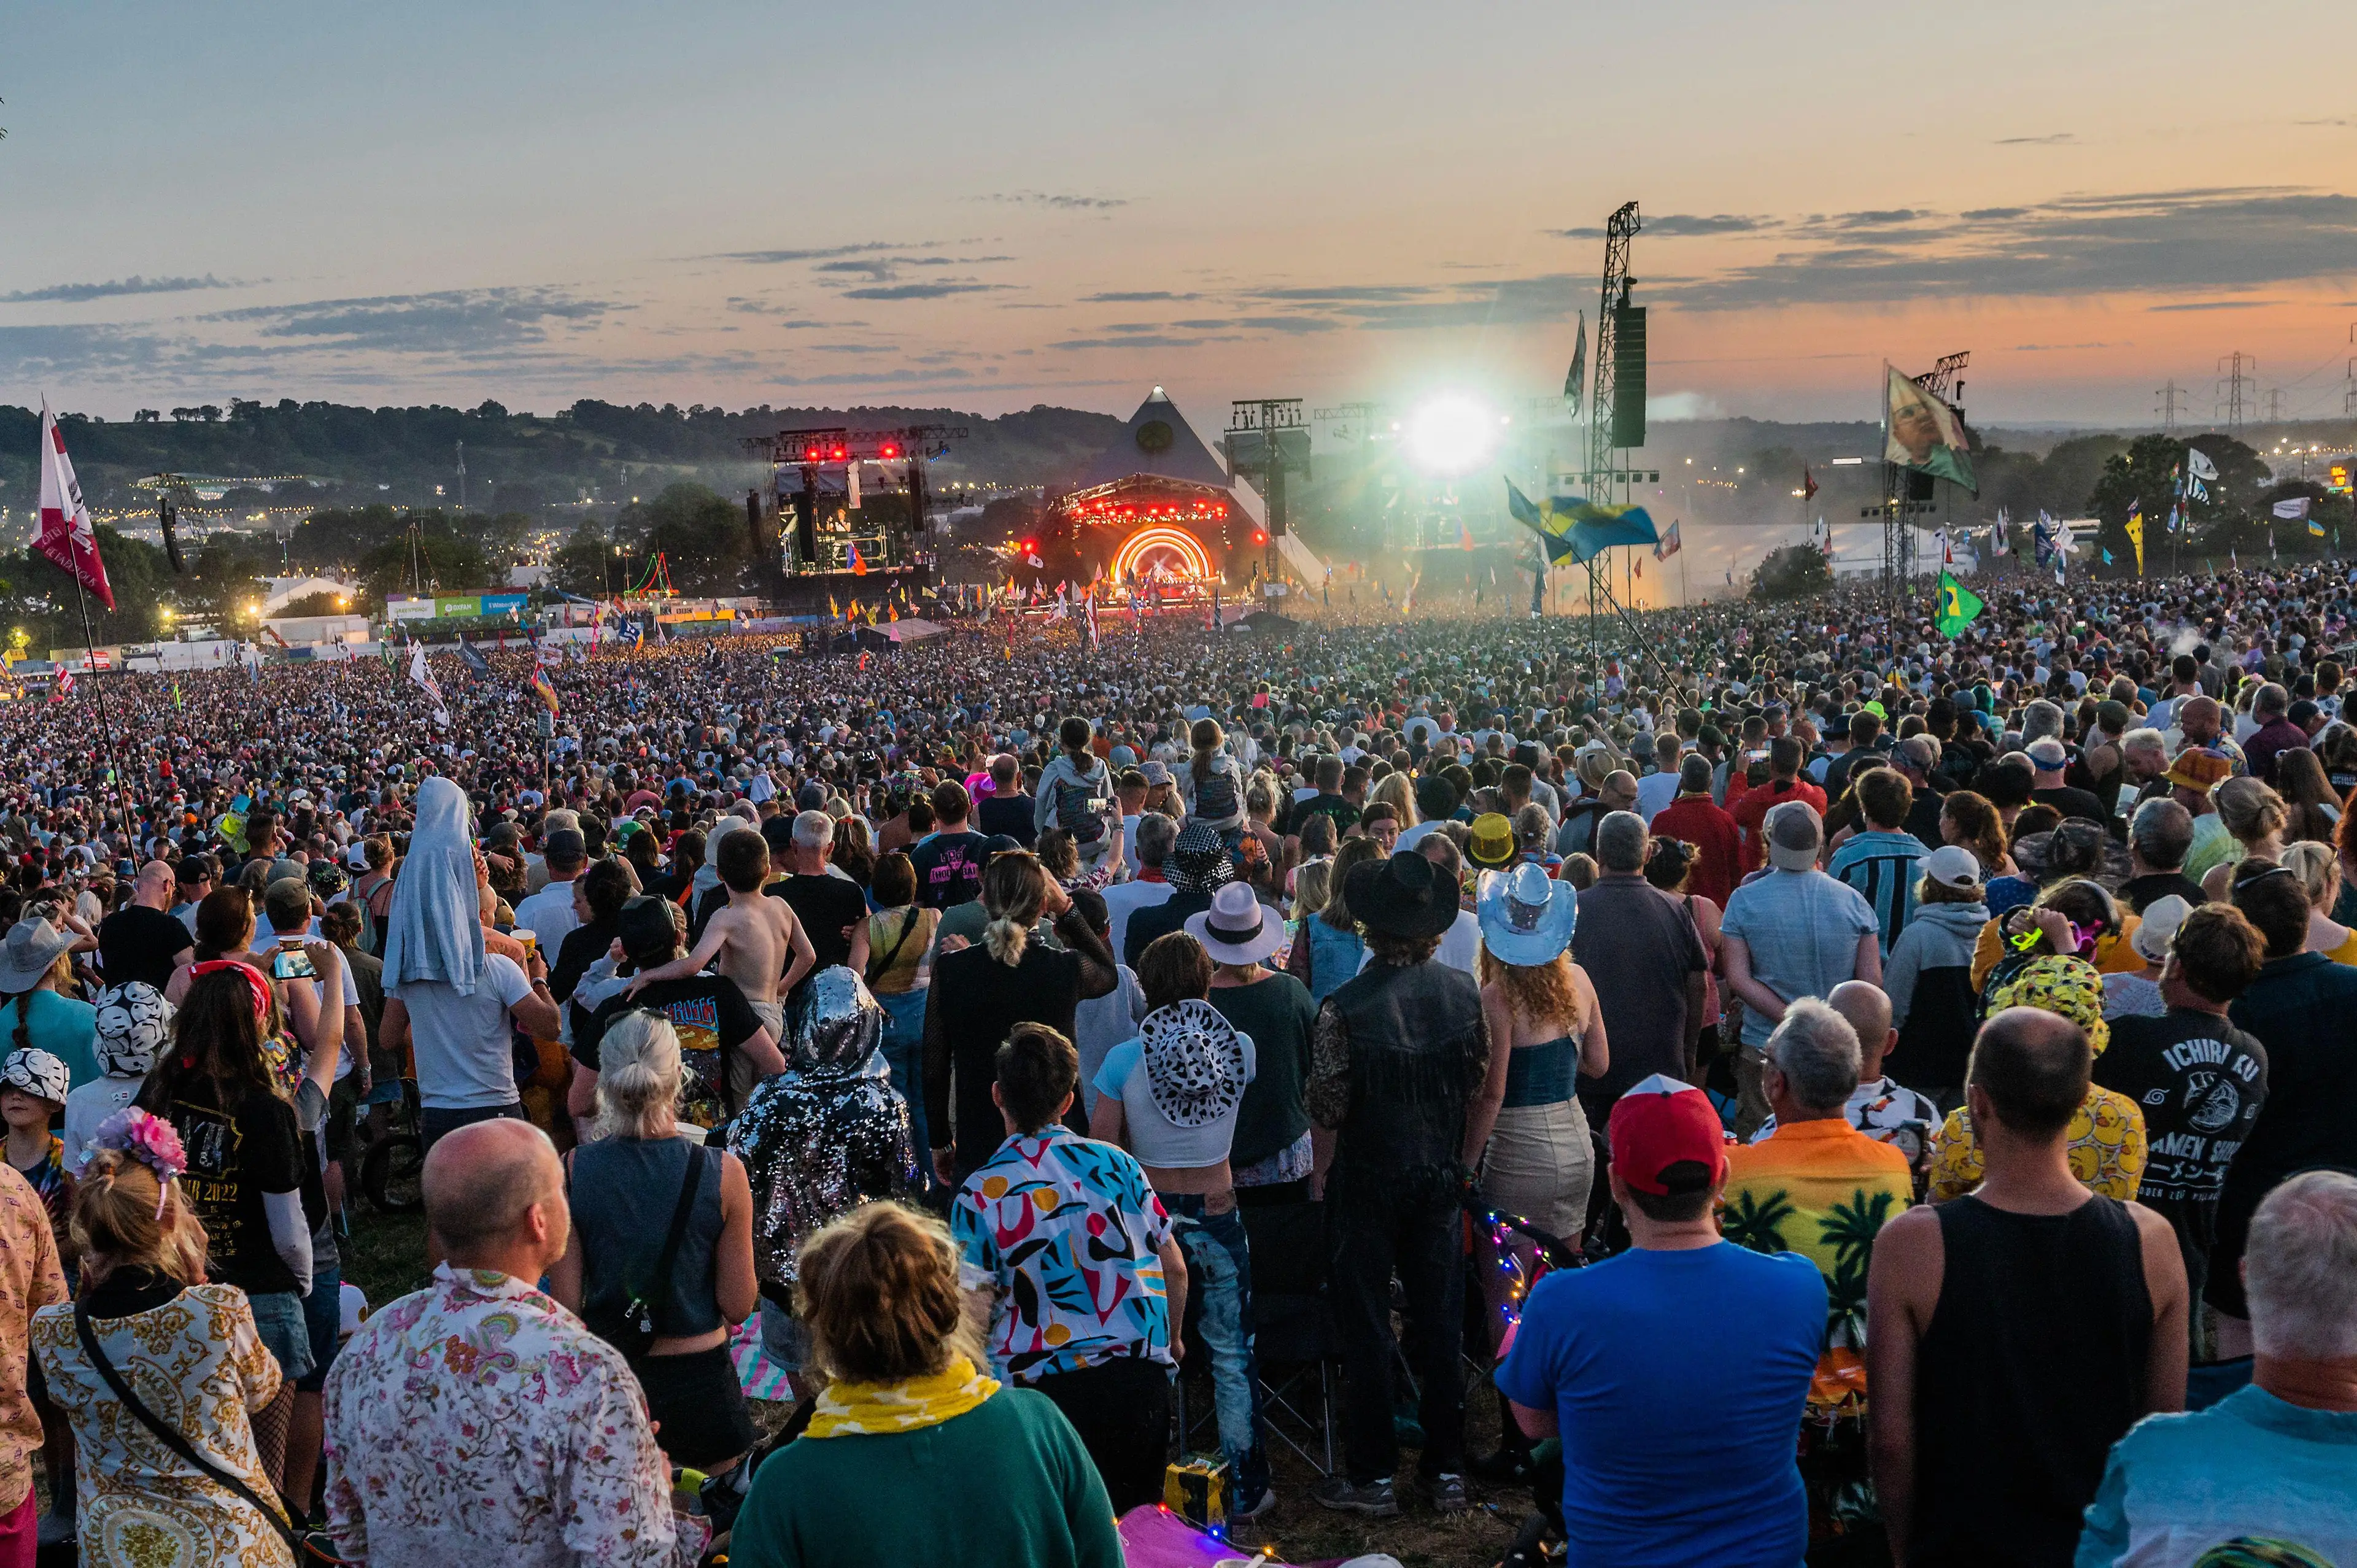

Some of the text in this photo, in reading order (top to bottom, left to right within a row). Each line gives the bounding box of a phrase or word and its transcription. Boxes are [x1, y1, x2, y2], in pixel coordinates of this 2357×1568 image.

[673, 995, 720, 1032] ROSES
[2150, 1131, 2208, 1161] AMEN
[204, 1182, 238, 1202] 2022
